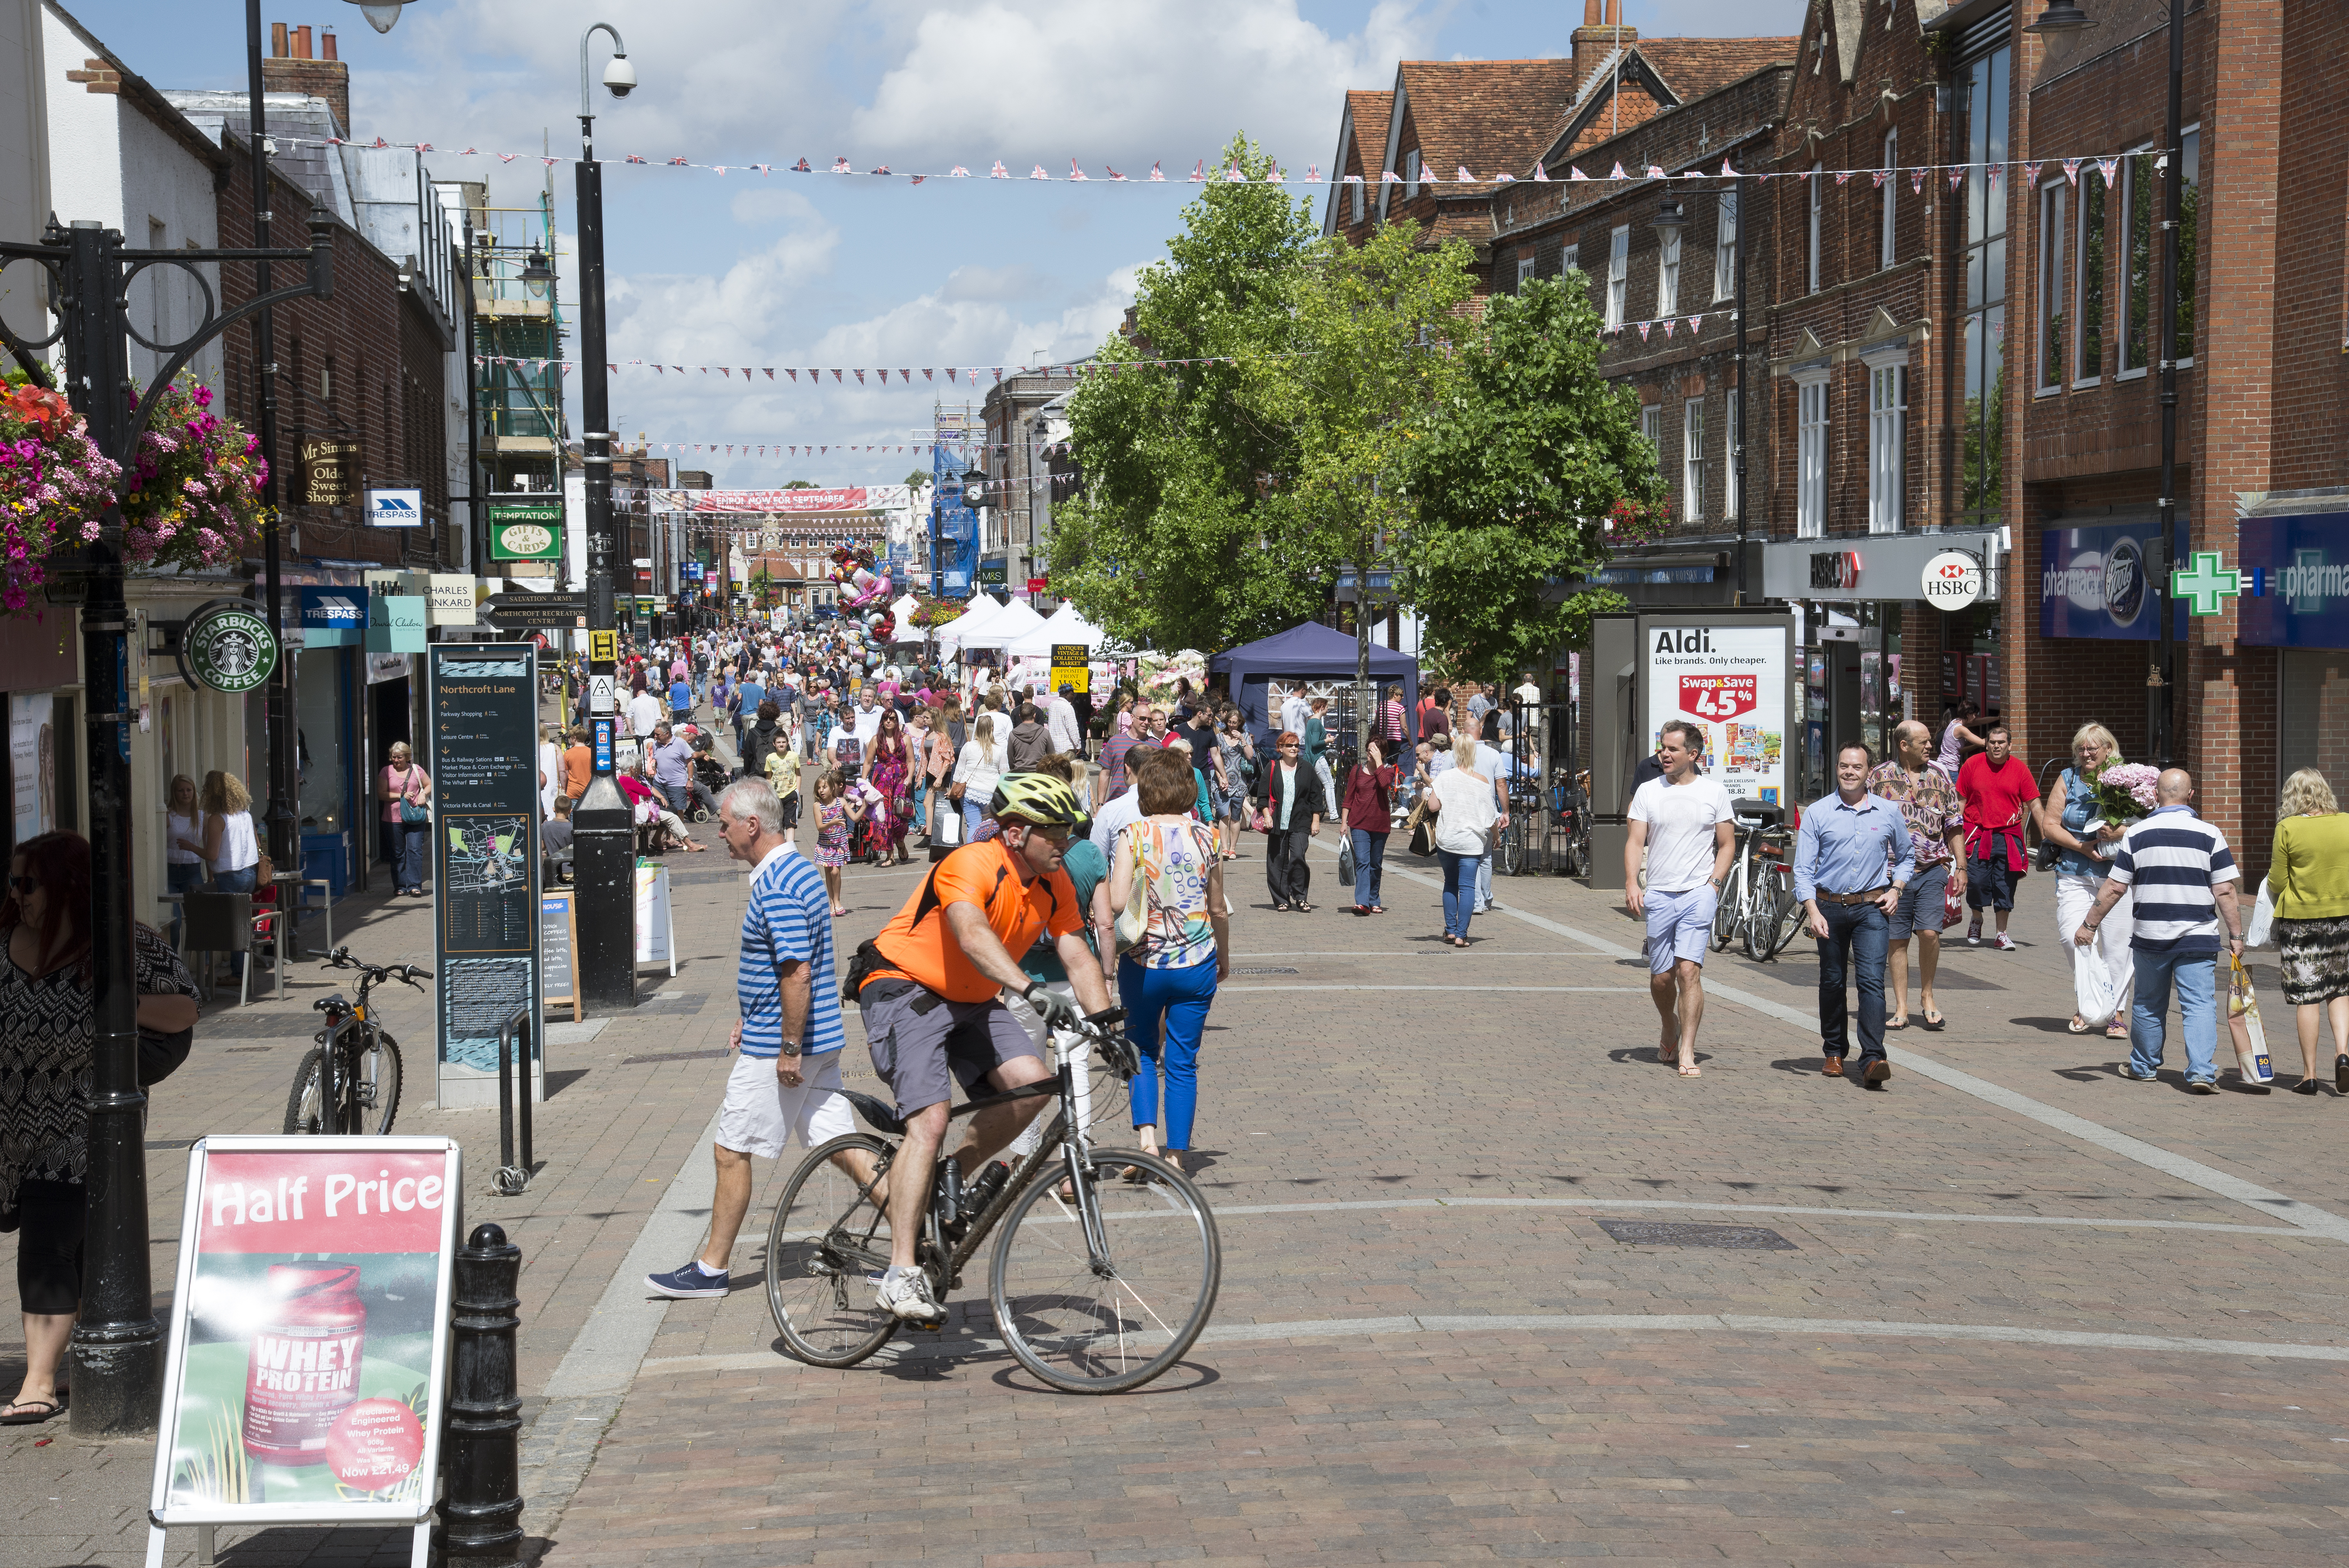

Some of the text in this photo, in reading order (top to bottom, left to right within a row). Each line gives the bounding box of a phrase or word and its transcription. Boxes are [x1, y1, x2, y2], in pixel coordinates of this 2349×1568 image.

[300, 442, 356, 463] Mr Simms
[314, 468, 344, 479] Olde
[311, 480, 348, 490] Sweet
[793, 495, 845, 504] SEPTEMBER
[509, 526, 543, 537] GIFTS
[53, 544, 78, 557] PLACE
[508, 539, 546, 552] CARDS
[983, 572, 1001, 581] M&S
[1658, 570, 1697, 581] CAMP HOPSON
[1809, 552, 1841, 588] HSBC
[2043, 563, 2099, 603] pharmacy
[2107, 557, 2134, 603] Boots
[1927, 581, 1977, 595] HSBC
[427, 599, 471, 607] LINKARD
[305, 610, 363, 619] TRESPASS
[369, 617, 423, 627] David Clulow
[196, 617, 271, 649] STARBUCKS
[1655, 628, 1716, 653] Aldi.
[1709, 657, 1728, 666] Only
[1730, 656, 1766, 665] cheaper.
[205, 668, 261, 688] COFFEE
[1059, 680, 1081, 688] M&S
[1682, 677, 1753, 690] Swap&Save
[440, 685, 491, 693] Northcroft
[1696, 690, 1752, 715] 45%
[1011, 805, 1044, 822] SPECIALIZED
[212, 1170, 442, 1226] Half Price
[257, 1335, 358, 1371] WHEY
[256, 1367, 352, 1392] PROTEIN
[301, 1401, 324, 1409] Growth
[356, 1407, 396, 1416] Precision
[351, 1414, 400, 1426] Engineered
[373, 1426, 404, 1436] Protein
[342, 1463, 409, 1477] Now £21.49
